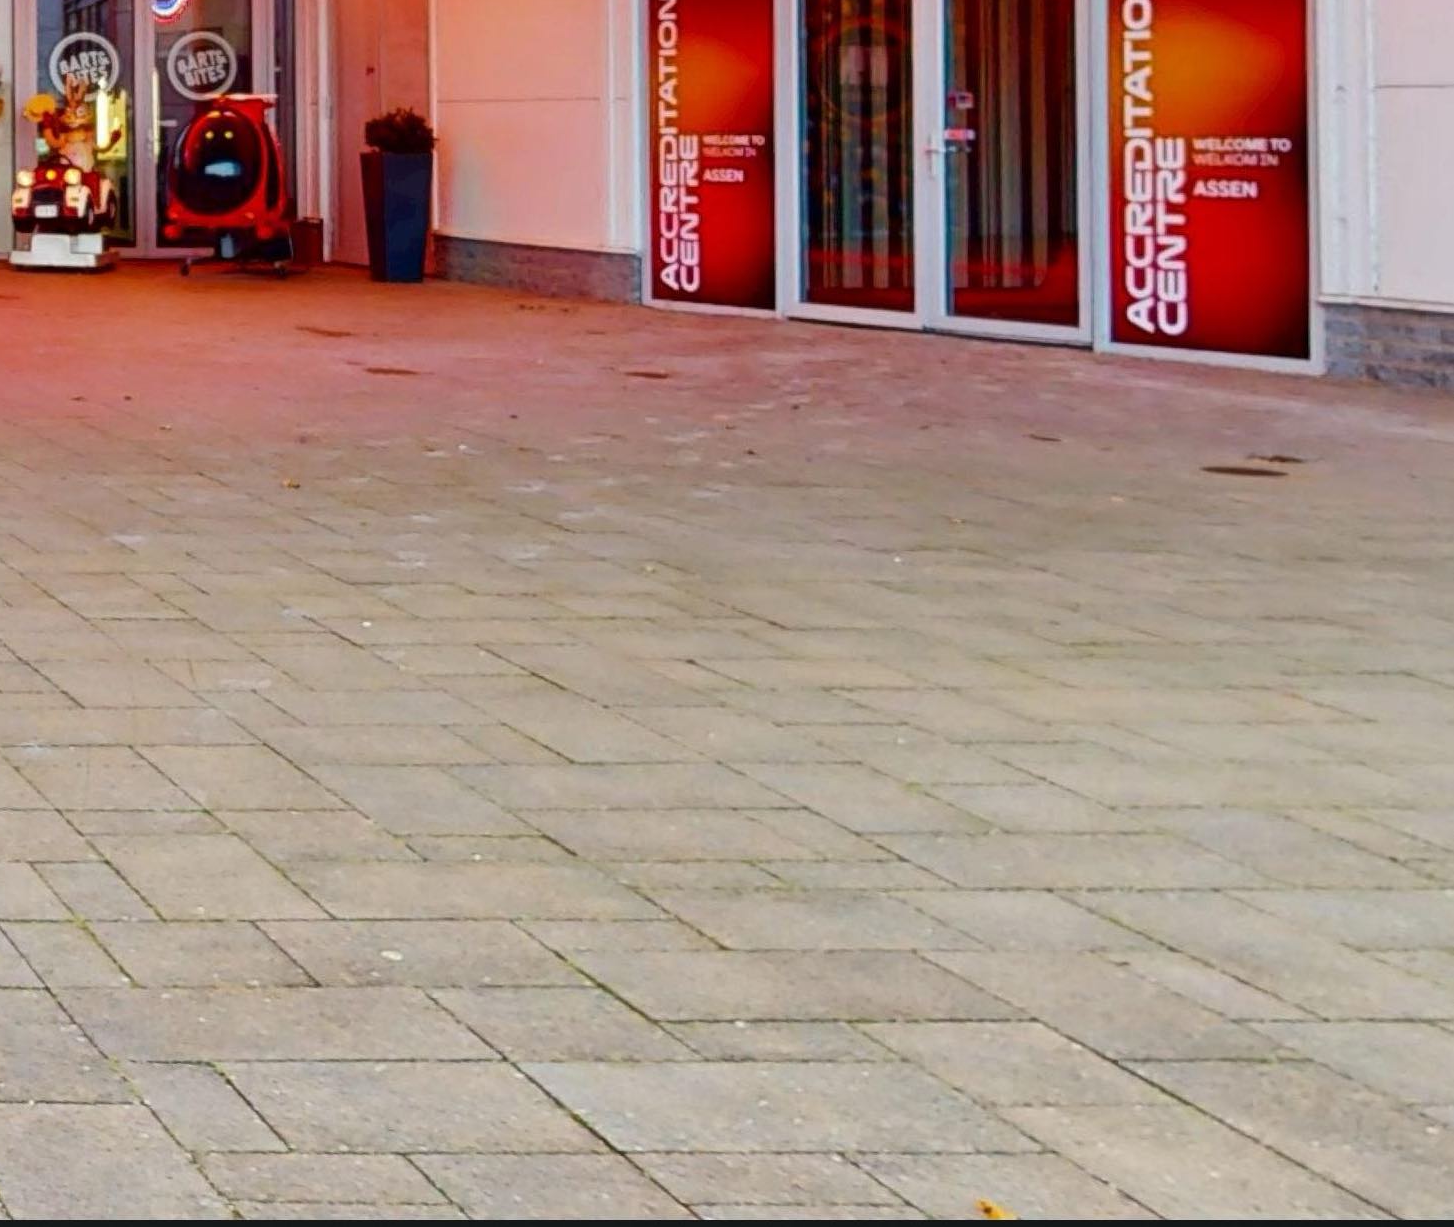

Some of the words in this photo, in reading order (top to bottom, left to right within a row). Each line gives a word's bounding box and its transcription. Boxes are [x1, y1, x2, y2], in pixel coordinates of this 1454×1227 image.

[703, 134, 750, 147] WELCOME
[751, 134, 766, 147] TO
[1193, 137, 1268, 152] WELCOME
[1269, 137, 1292, 153] TO
[1193, 152, 1258, 166] WELKOM
[1260, 153, 1280, 167] IN
[702, 168, 745, 183] ASSEN
[1193, 180, 1259, 199] ASSEN
[678, 134, 701, 293] CENTRE
[1155, 137, 1188, 336] CENTRE
